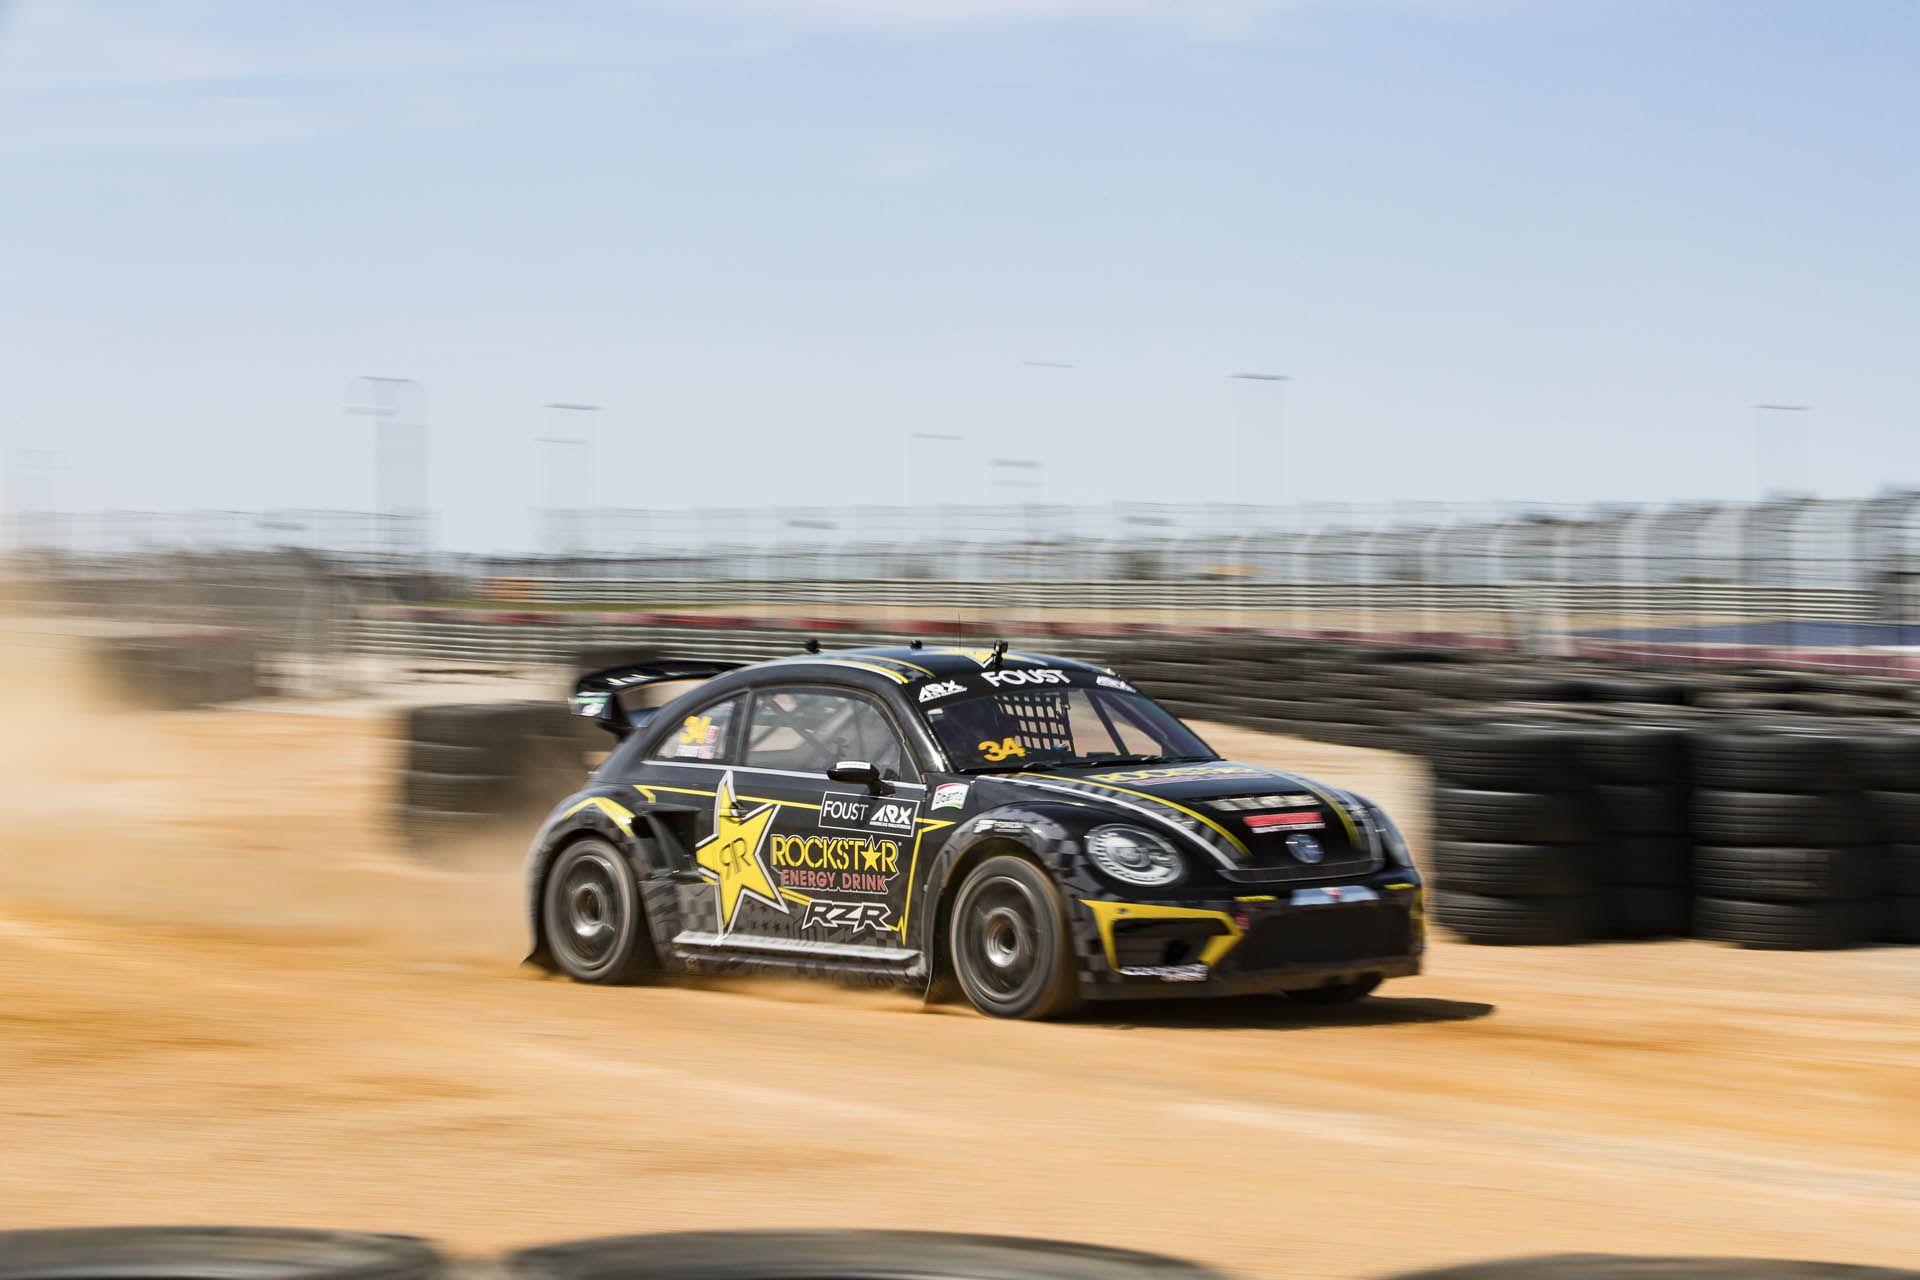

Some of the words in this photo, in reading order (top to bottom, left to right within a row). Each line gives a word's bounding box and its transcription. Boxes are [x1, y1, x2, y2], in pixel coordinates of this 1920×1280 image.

[981, 669, 1071, 687] FOUST
[978, 738, 1025, 761] 34
[822, 800, 869, 821] FOUST
[870, 804, 912, 826] ARX
[781, 869, 836, 888] ENERGY
[842, 871, 887, 892] DRINK
[801, 900, 892, 933] RZR
